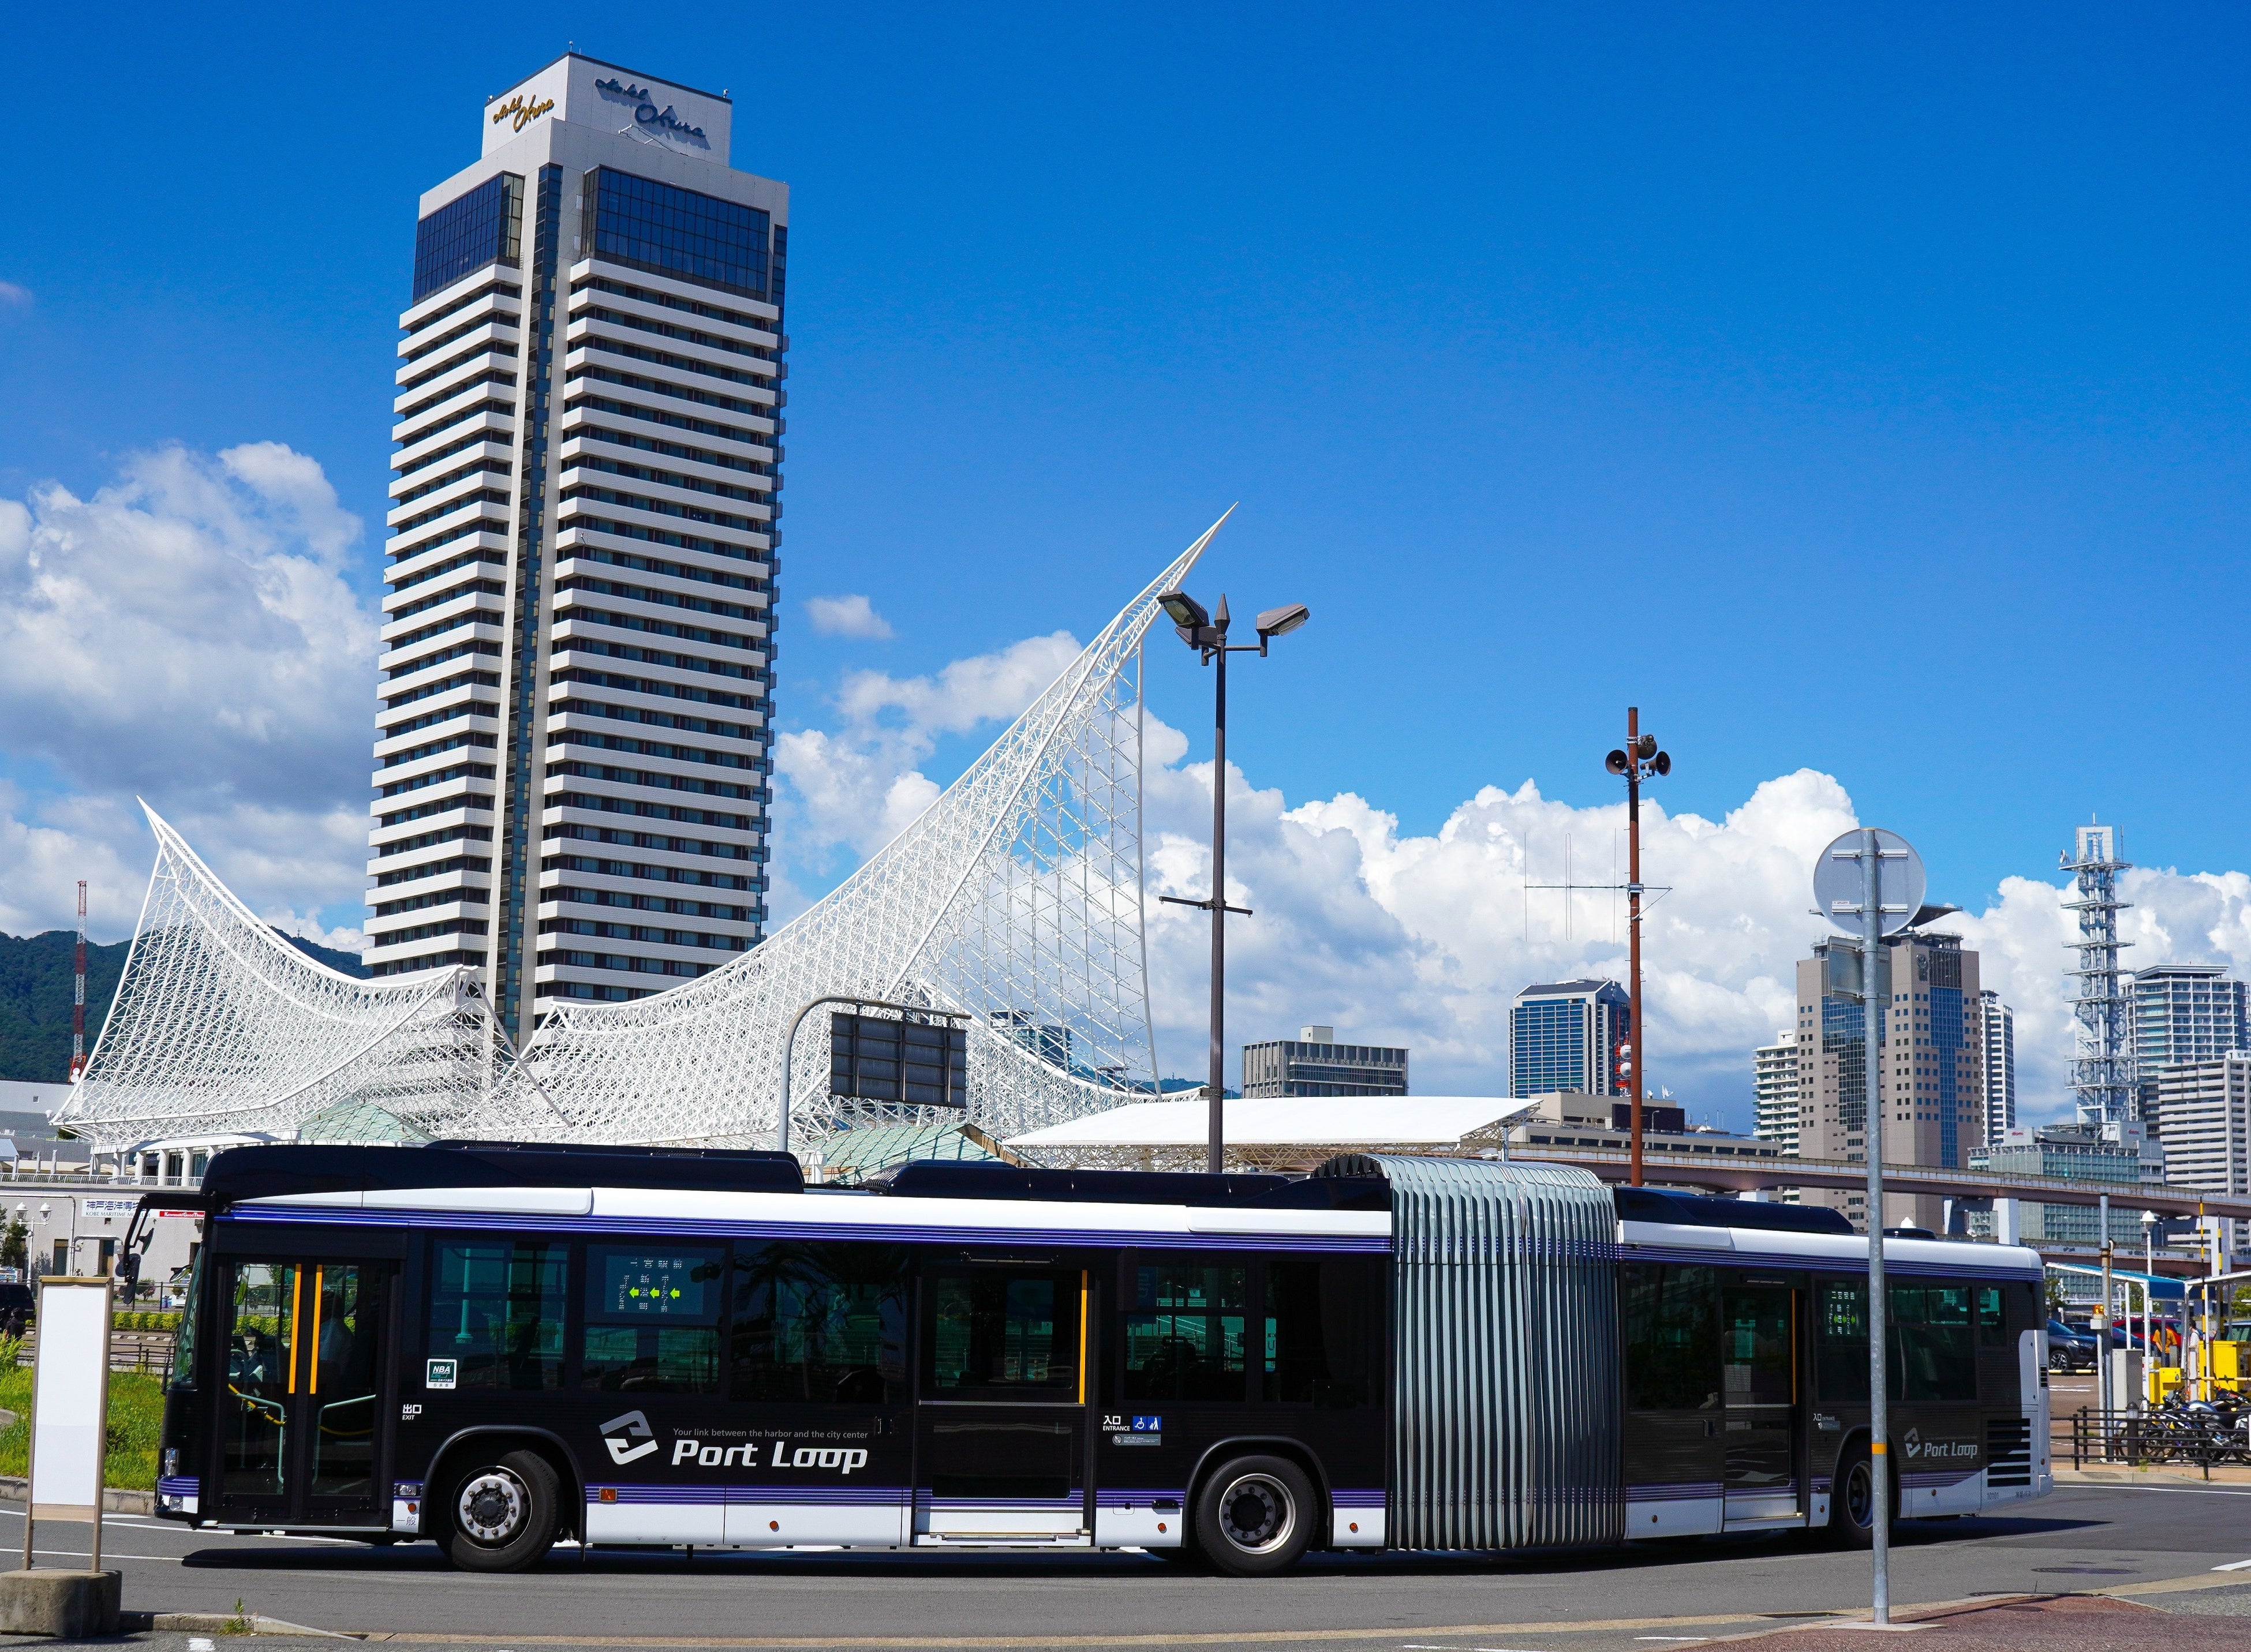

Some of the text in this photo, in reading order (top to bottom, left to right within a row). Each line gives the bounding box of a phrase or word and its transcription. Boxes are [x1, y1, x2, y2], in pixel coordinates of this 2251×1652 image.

[513, 95, 554, 133] Okura
[635, 104, 706, 138] Okura
[433, 1366, 450, 1374] NBA
[403, 1404, 422, 1414] 出口
[1103, 1415, 1121, 1425] 入口
[673, 1428, 692, 1436] Your
[694, 1428, 709, 1436] link
[712, 1429, 746, 1437] between
[827, 1431, 841, 1440] city
[1924, 1442, 1977, 1459] Port Loop
[671, 1440, 868, 1474] Port Loop
[395, 1516, 417, 1526] 一般
